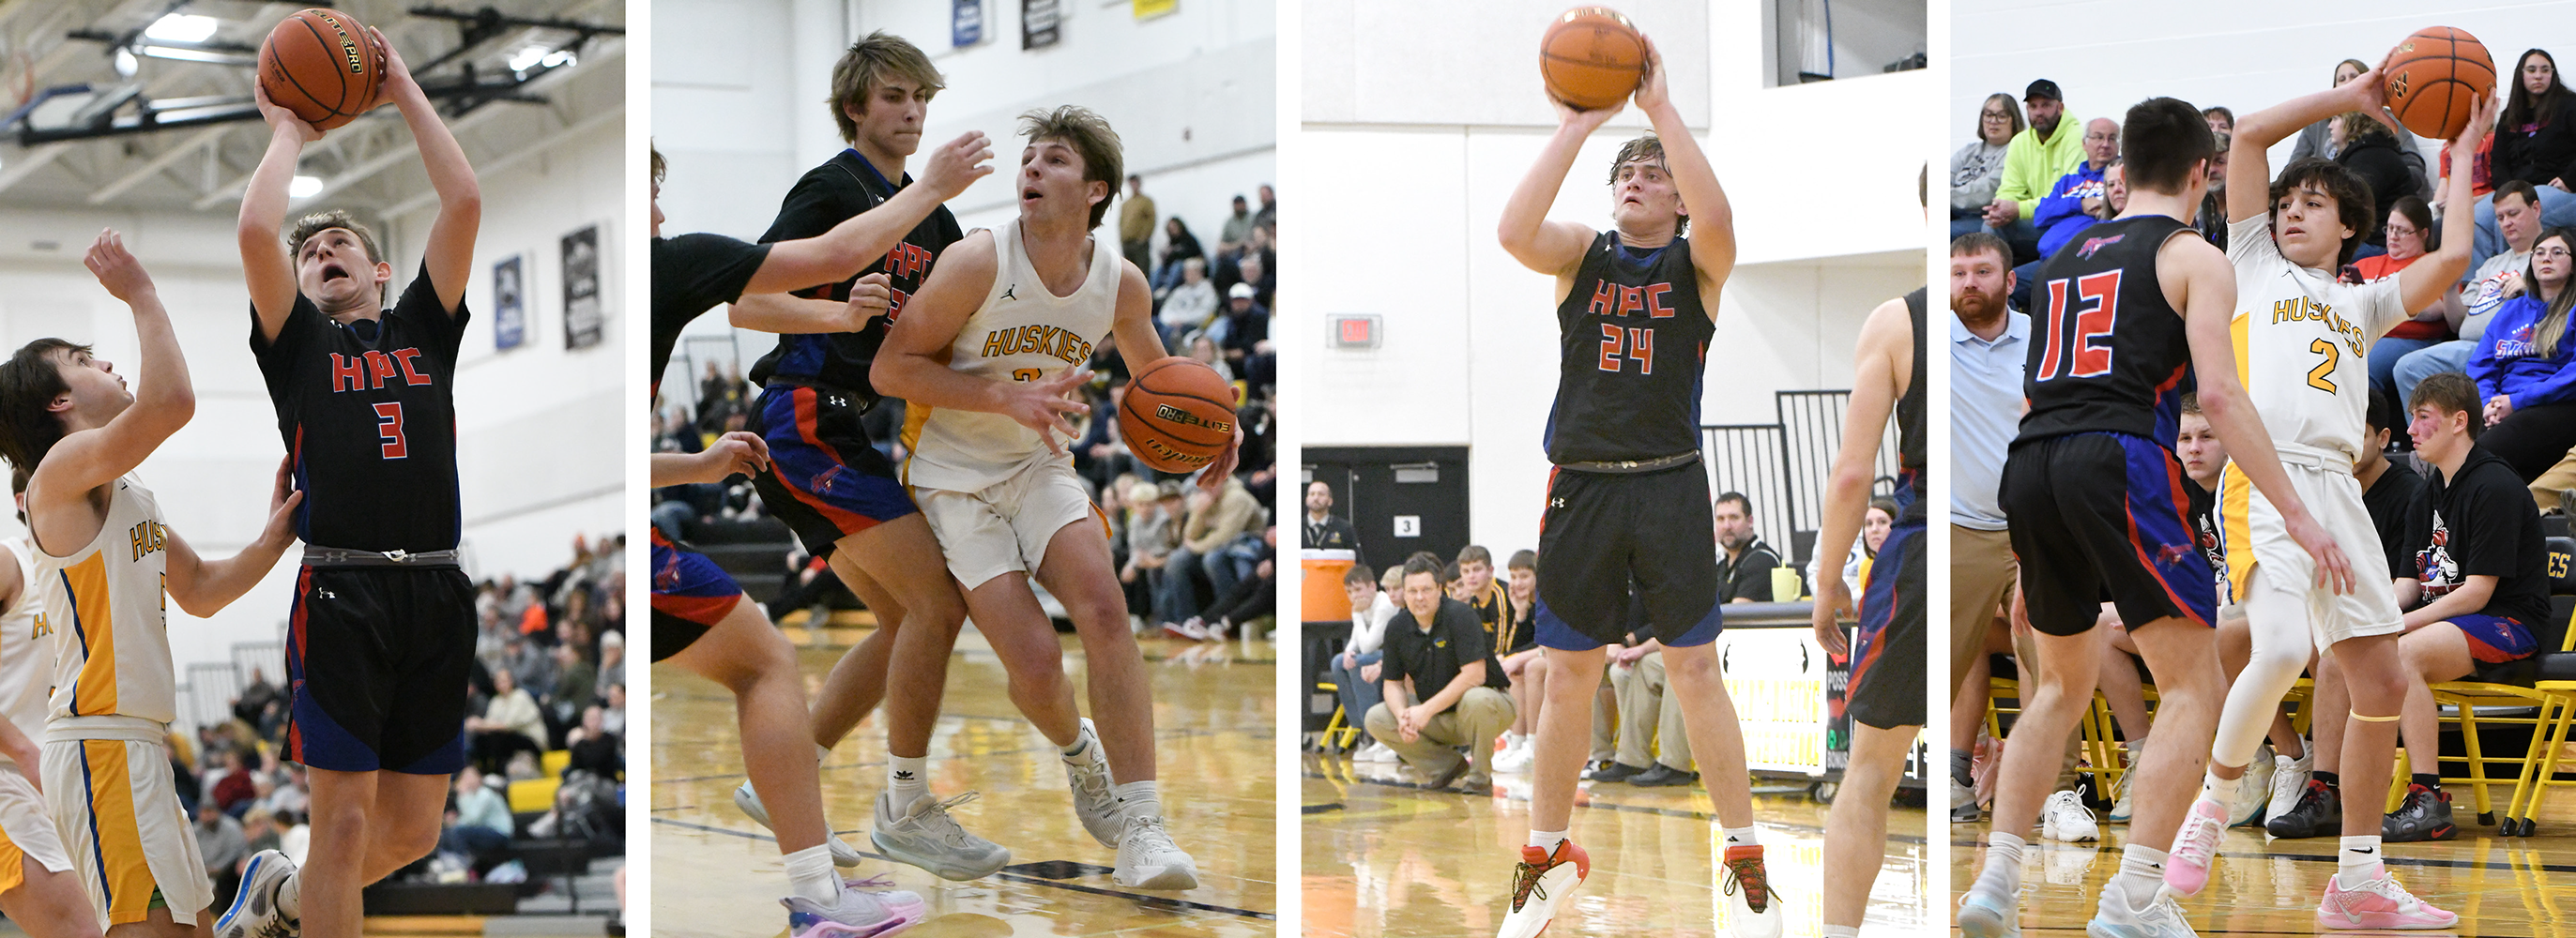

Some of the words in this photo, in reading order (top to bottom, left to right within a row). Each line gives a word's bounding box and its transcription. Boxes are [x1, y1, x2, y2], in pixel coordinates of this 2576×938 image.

[343, 43, 363, 74] PRO
[1588, 278, 1675, 319] HPC
[981, 324, 1091, 368] HUSKIES
[1598, 323, 1654, 375] 24
[2035, 267, 2124, 382] 12
[2272, 295, 2365, 358] HUSKIES
[328, 346, 433, 393] HPC
[2307, 337, 2340, 396] 2
[372, 401, 408, 460] 3
[1403, 520, 1411, 533] 3
